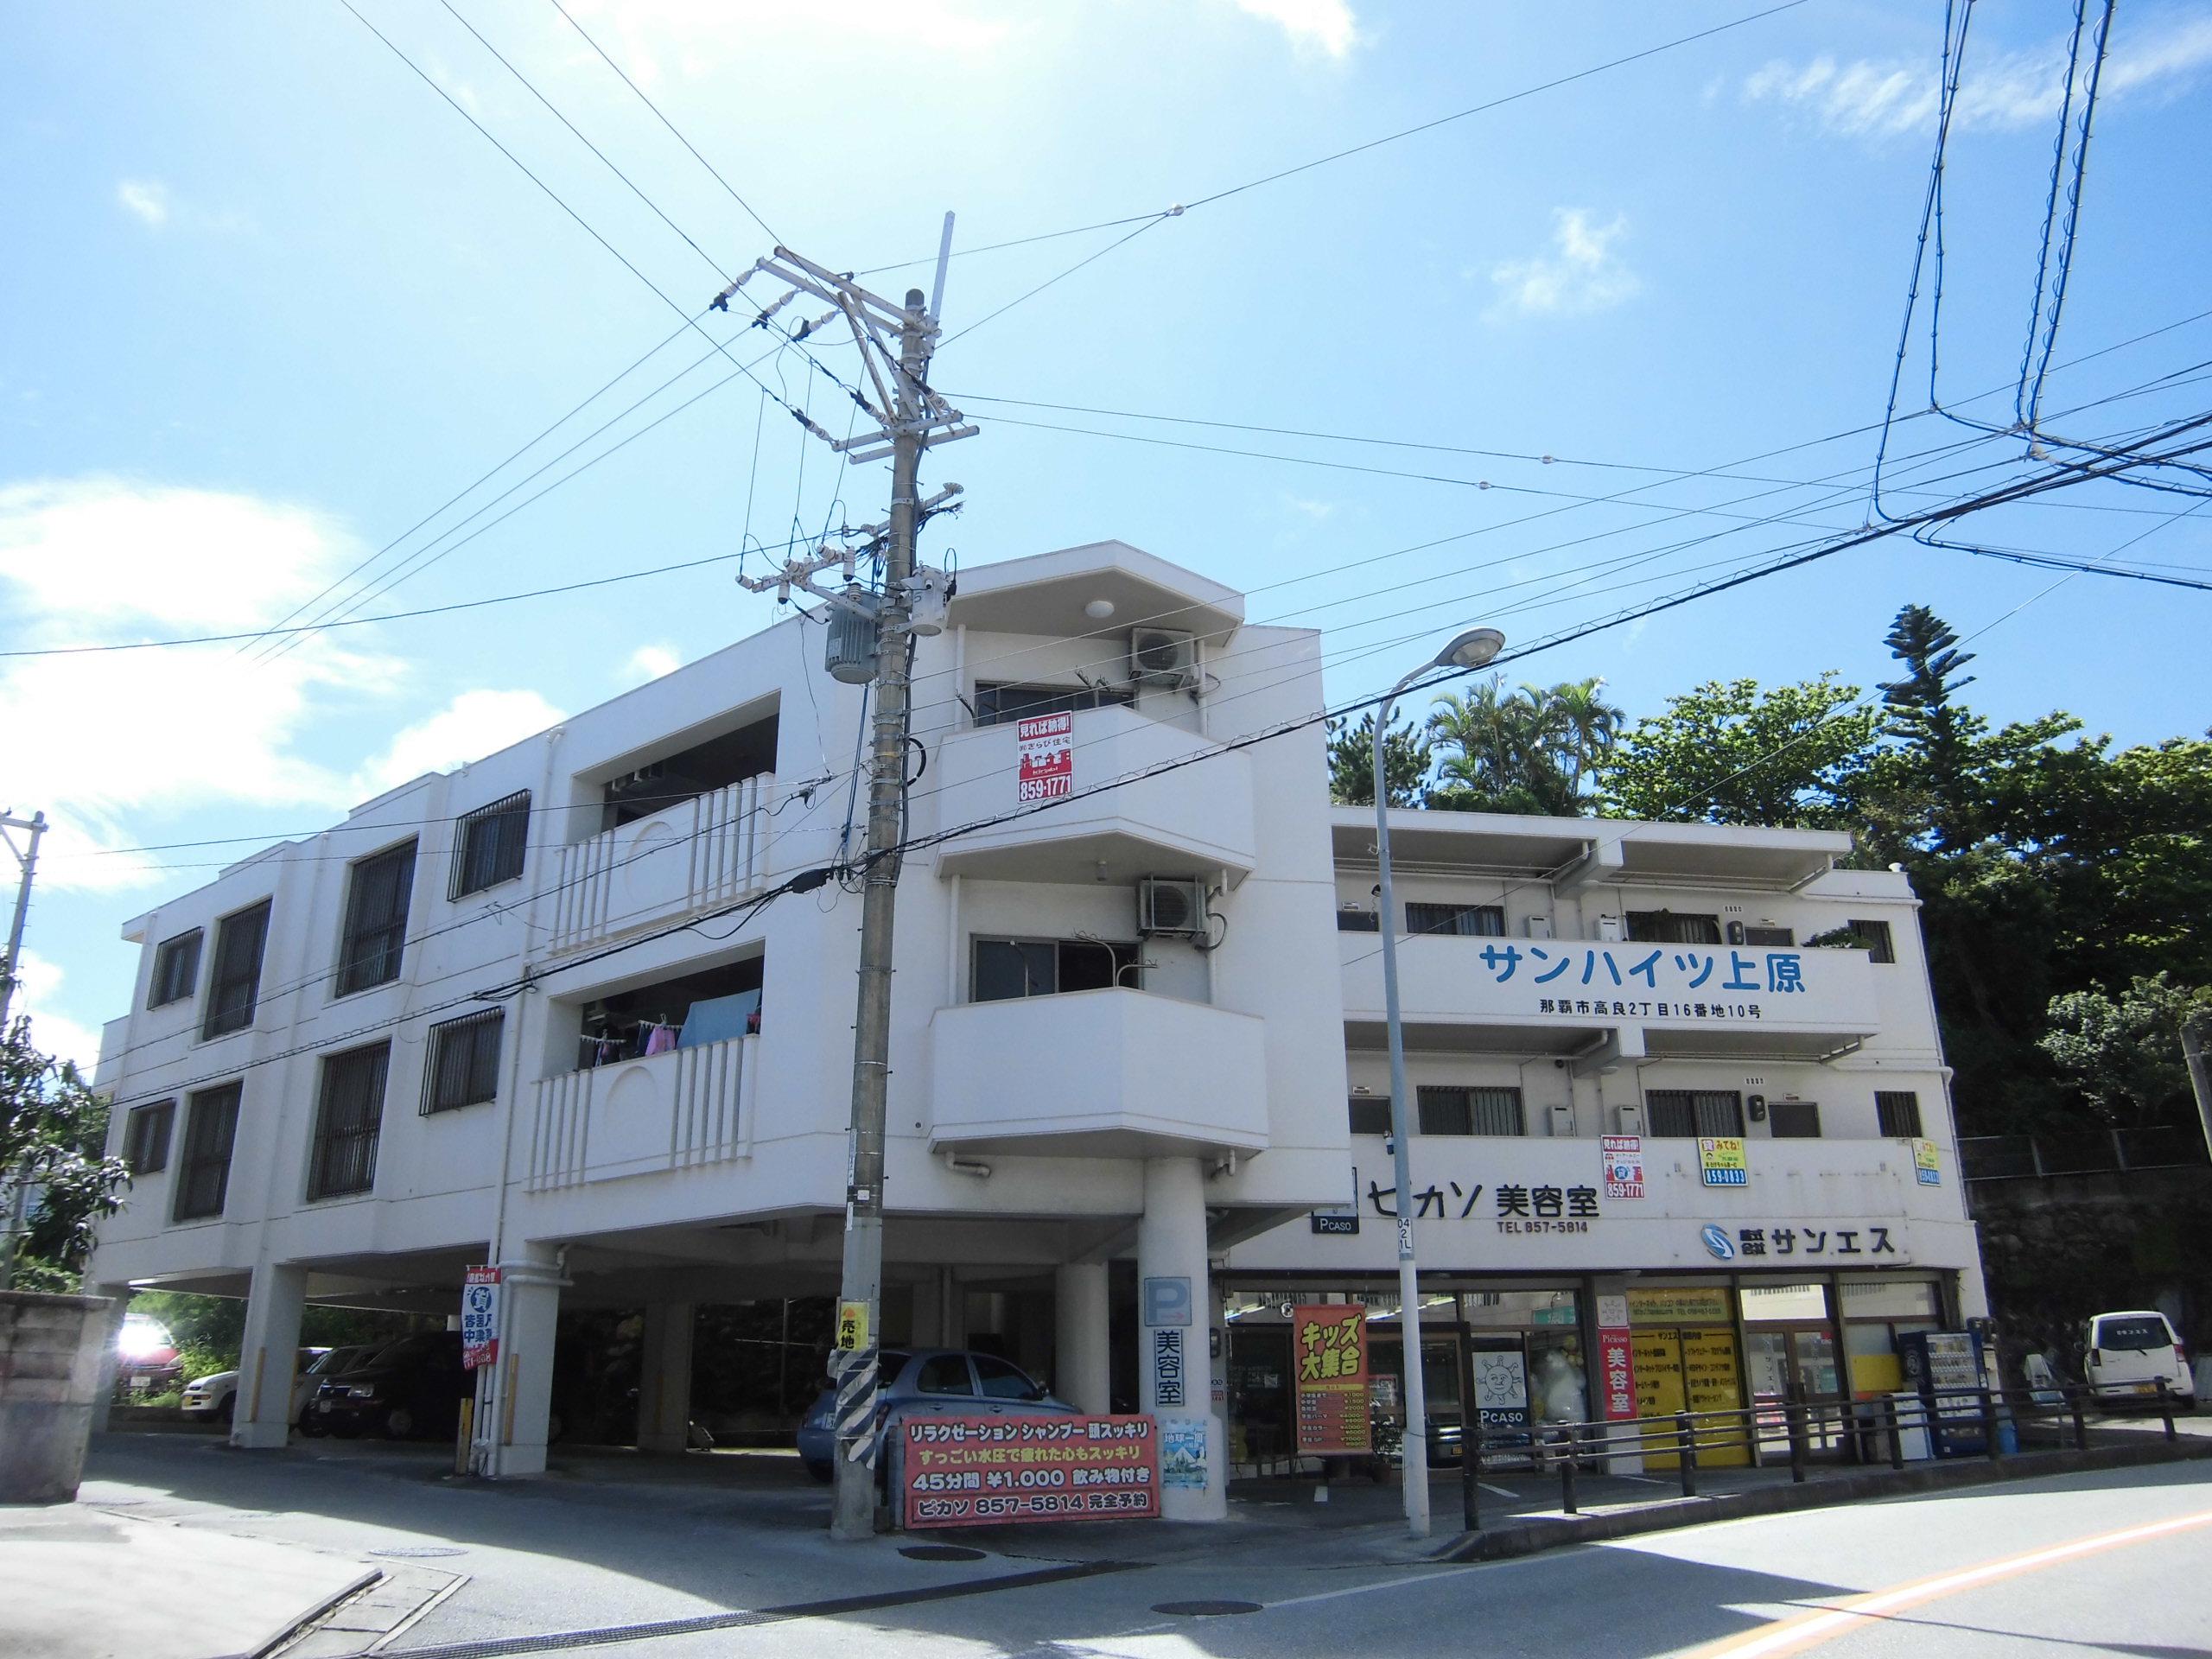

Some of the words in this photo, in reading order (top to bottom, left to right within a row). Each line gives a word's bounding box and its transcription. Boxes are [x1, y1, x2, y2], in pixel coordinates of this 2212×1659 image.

[1478, 944, 1807, 994] サンハイツ上原
[1540, 999, 1762, 1019] 那覇市高良2丁目16番地10号
[1496, 1184, 1600, 1217] 美容室
[1397, 1218, 1409, 1228] 04
[1401, 1229, 1408, 1239] 2
[1497, 1221, 1522, 1233] TEL
[1525, 1221, 1588, 1233] 857-5814
[1771, 1228, 1896, 1254] サンエス
[1148, 1281, 1188, 1322] P
[840, 1319, 855, 1350] 売地
[1301, 1313, 1362, 1351] キッズ
[1156, 1330, 1181, 1404] 美容室
[1300, 1344, 1362, 1382] 大集合
[1607, 1346, 1631, 1414] 美容室
[911, 1423, 1019, 1443] リラクゼーション
[1021, 1421, 1086, 1441] シャンプー
[1088, 1421, 1148, 1440] 頭スッキリ
[918, 1445, 1141, 1465] すっごい水圧で疲れた心もスッキリ
[912, 1471, 981, 1491] 45分間
[1072, 1467, 1151, 1486] 飲み物付き
[918, 1498, 970, 1517] ピカソ
[975, 1494, 1085, 1515] 857-5814
[1087, 1492, 1149, 1510] 完全予約
